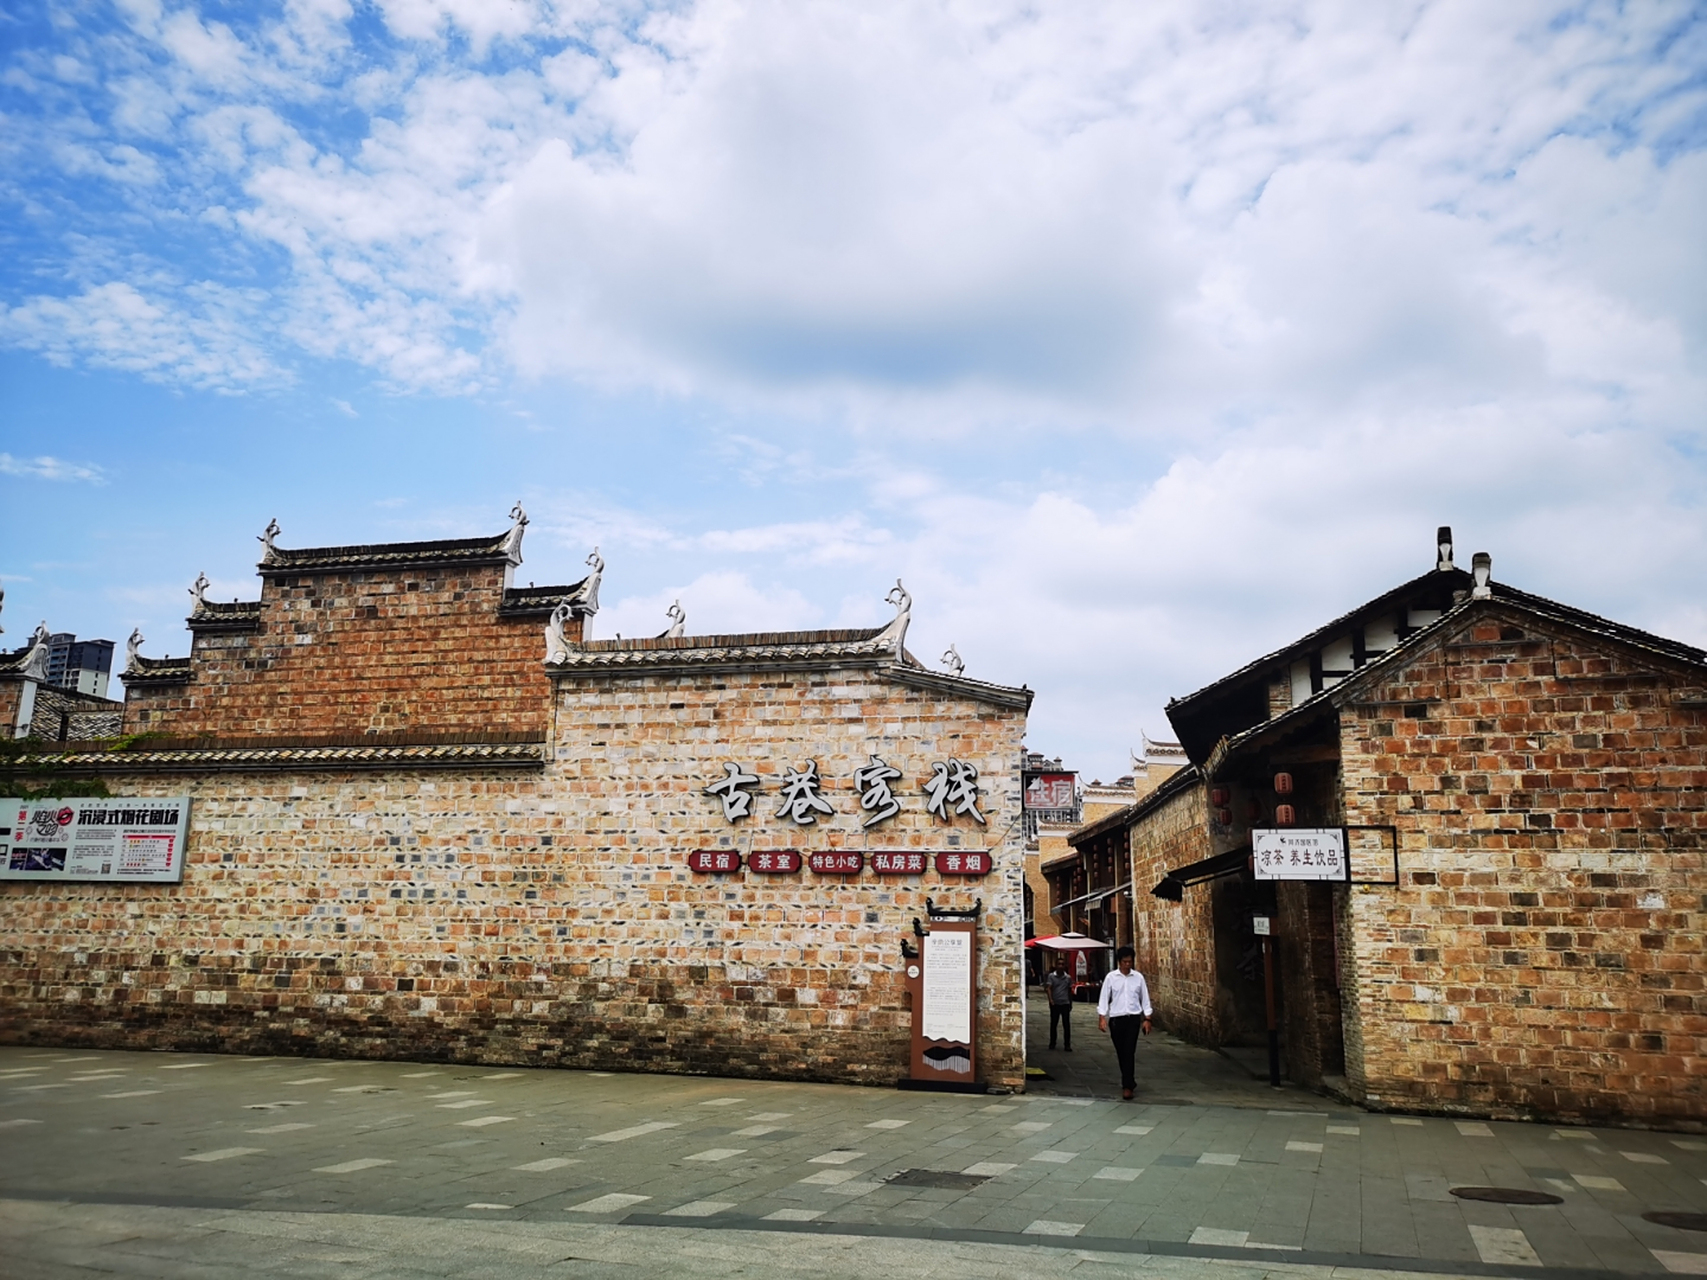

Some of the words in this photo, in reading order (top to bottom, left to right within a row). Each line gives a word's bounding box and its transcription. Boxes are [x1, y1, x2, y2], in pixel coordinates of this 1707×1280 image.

[702, 755, 986, 828] 古巷客栈
[1028, 779, 1071, 804] 住宿
[77, 809, 179, 825] 沉浸式烟花剧场
[699, 854, 730, 869] 民宿
[758, 854, 791, 869] 茶室
[812, 855, 859, 869] 特色小吃
[875, 854, 922, 870] 私房菜
[946, 854, 982, 870] 香烟
[1261, 849, 1284, 866] 凉茶
[1290, 849, 1338, 866] 养生饮品
